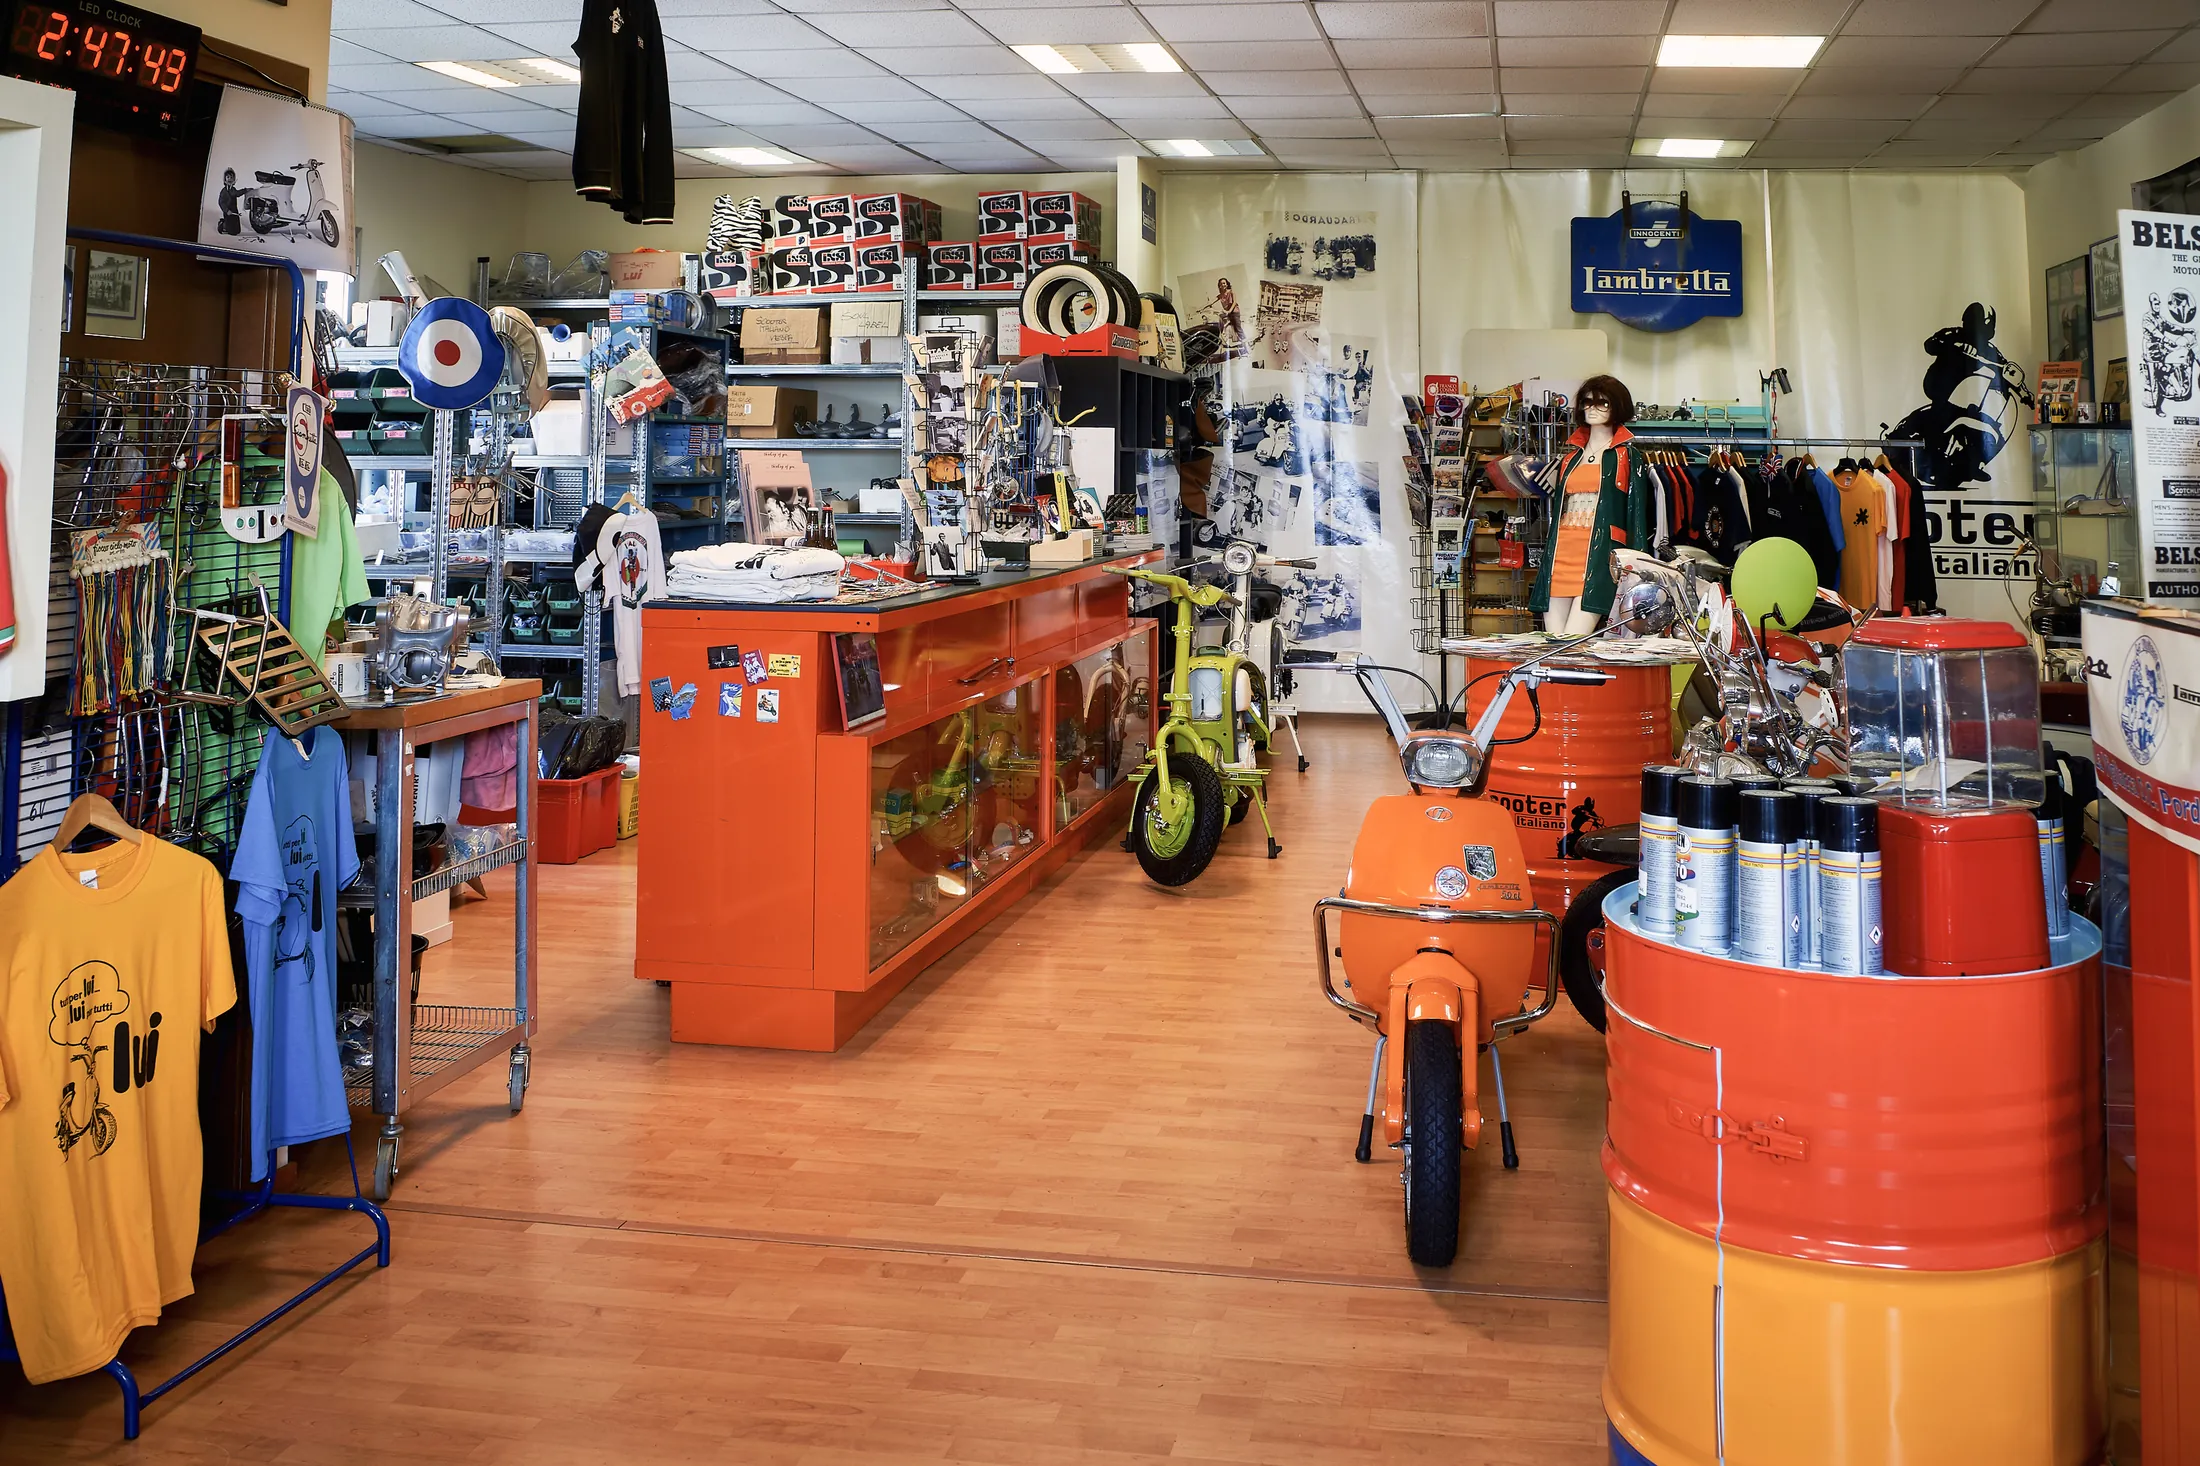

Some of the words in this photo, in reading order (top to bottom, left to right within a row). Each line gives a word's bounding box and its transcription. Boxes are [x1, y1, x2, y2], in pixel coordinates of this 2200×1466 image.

[79, 1, 100, 15] LED
[106, 9, 142, 29] CLOCK
[1633, 230, 1680, 238] INNOCENTI
[2172, 254, 2188, 262] THE
[2173, 266, 2200, 276] MOTO
[1583, 266, 1731, 297] Lambretta
[1935, 552, 2038, 577] talian
[2155, 585, 2200, 595] AUTHO
[1516, 815, 1566, 829] Italiano
[290, 847, 302, 865] lui
[68, 992, 82, 1004] per
[69, 1000, 85, 1024] lui
[93, 1002, 113, 1014] tutti
[113, 1011, 162, 1093] lui
